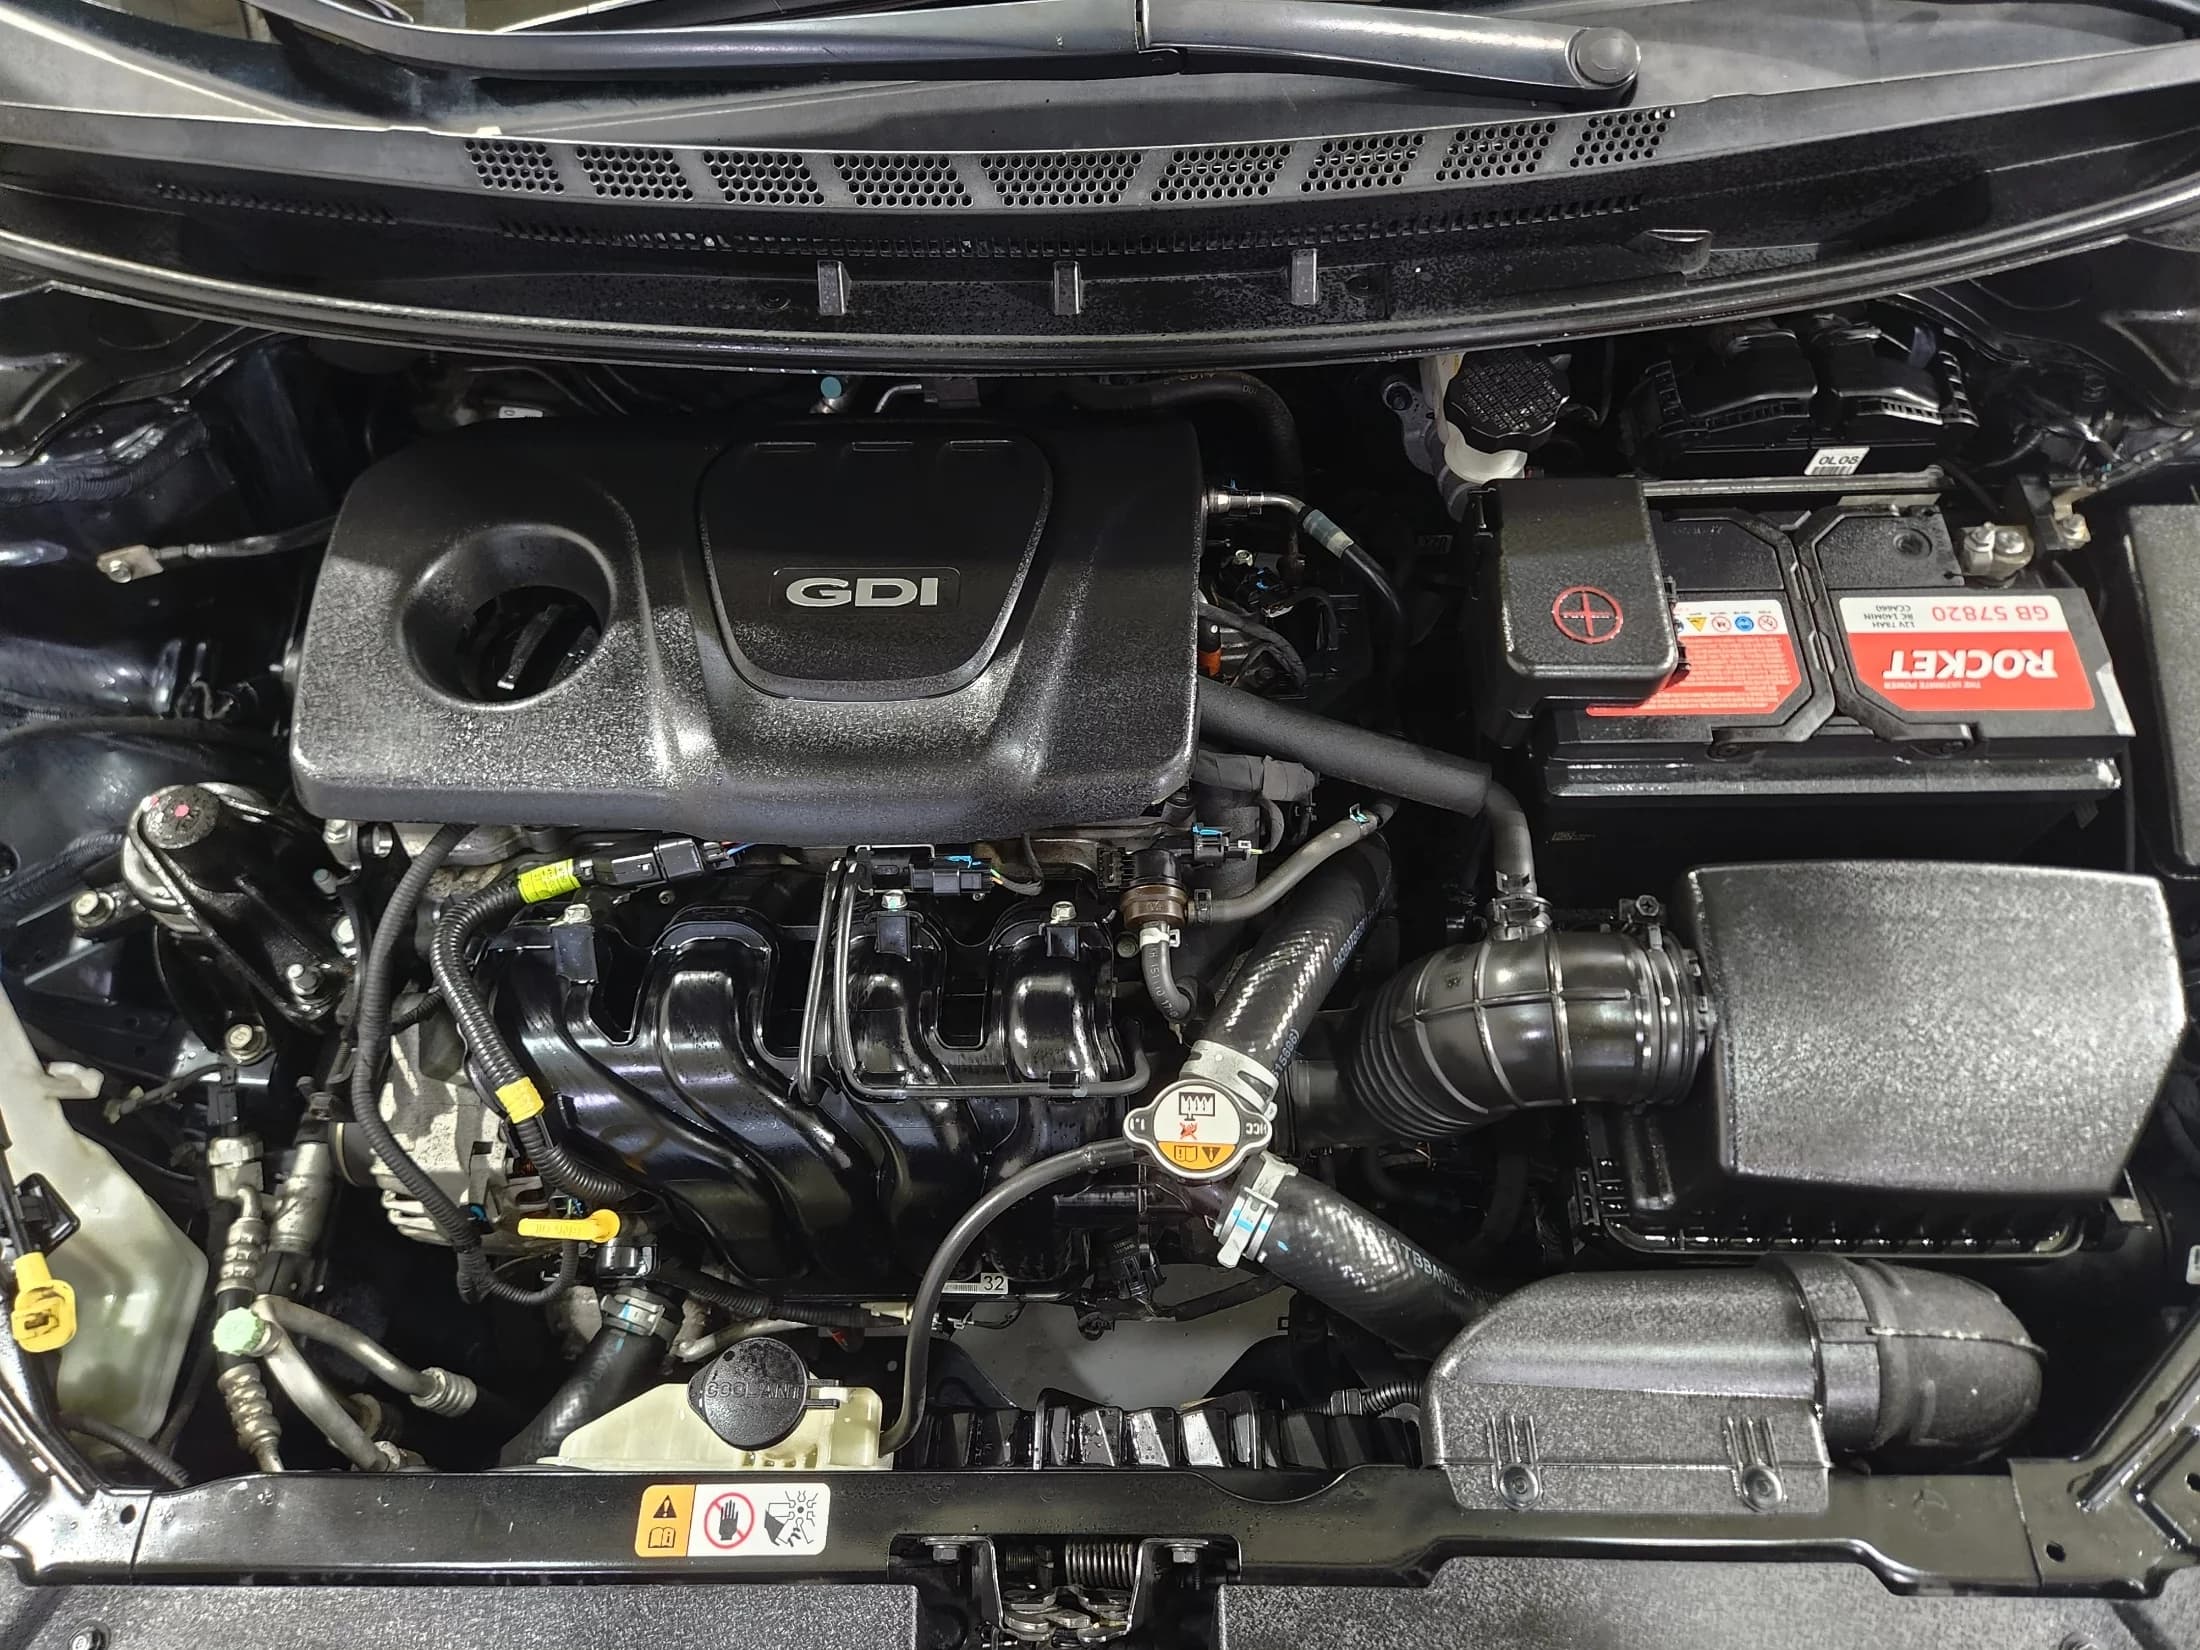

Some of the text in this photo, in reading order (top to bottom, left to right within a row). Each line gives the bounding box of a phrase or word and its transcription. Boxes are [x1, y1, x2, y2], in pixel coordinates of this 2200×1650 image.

[786, 577, 938, 607] GDI
[1931, 605, 2049, 622] GB 57820
[1883, 648, 2058, 679] ROCKET
[1884, 681, 1917, 690] POWER
[983, 1275, 1005, 1291] 32
[705, 1381, 804, 1400] COOLANT
